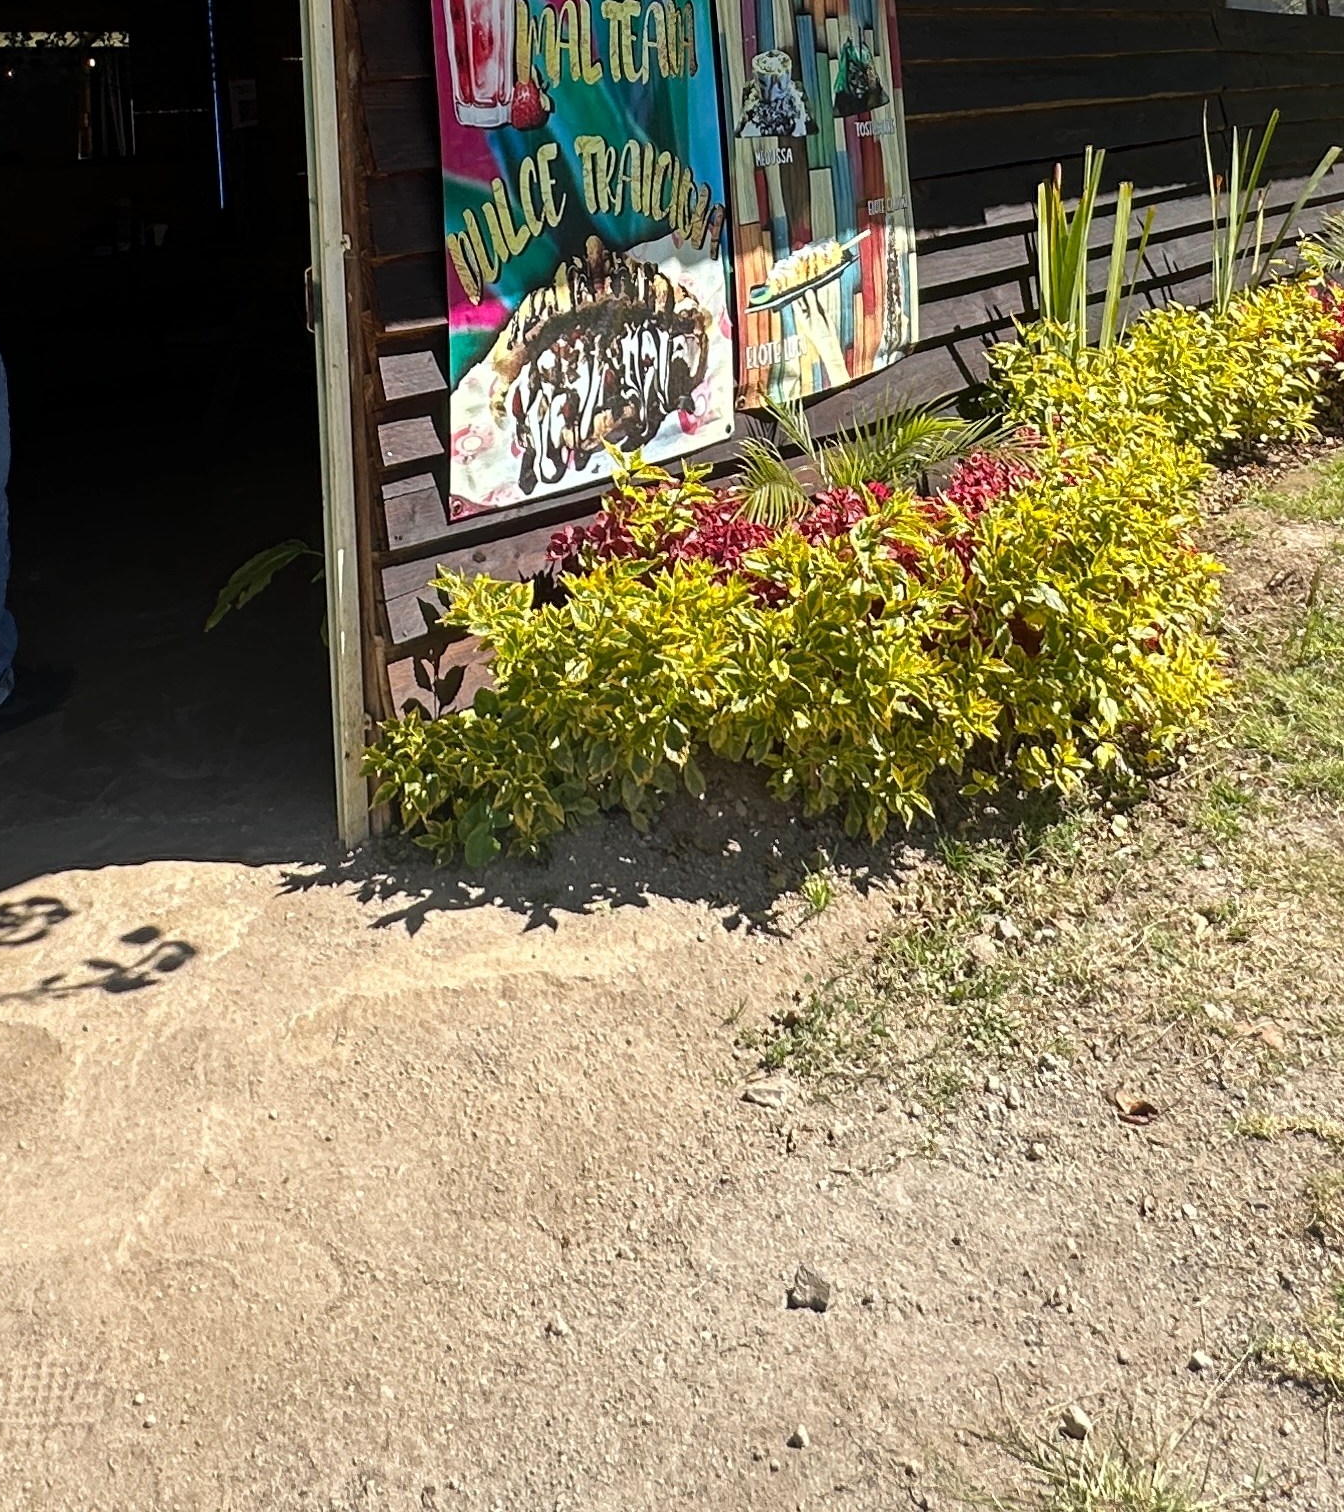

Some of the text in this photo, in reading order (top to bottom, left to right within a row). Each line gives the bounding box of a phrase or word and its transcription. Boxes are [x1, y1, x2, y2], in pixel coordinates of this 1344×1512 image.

[755, 147, 793, 166] MEDUSSA
[448, 143, 566, 306] DULCE
[746, 342, 781, 369] ELOTE
